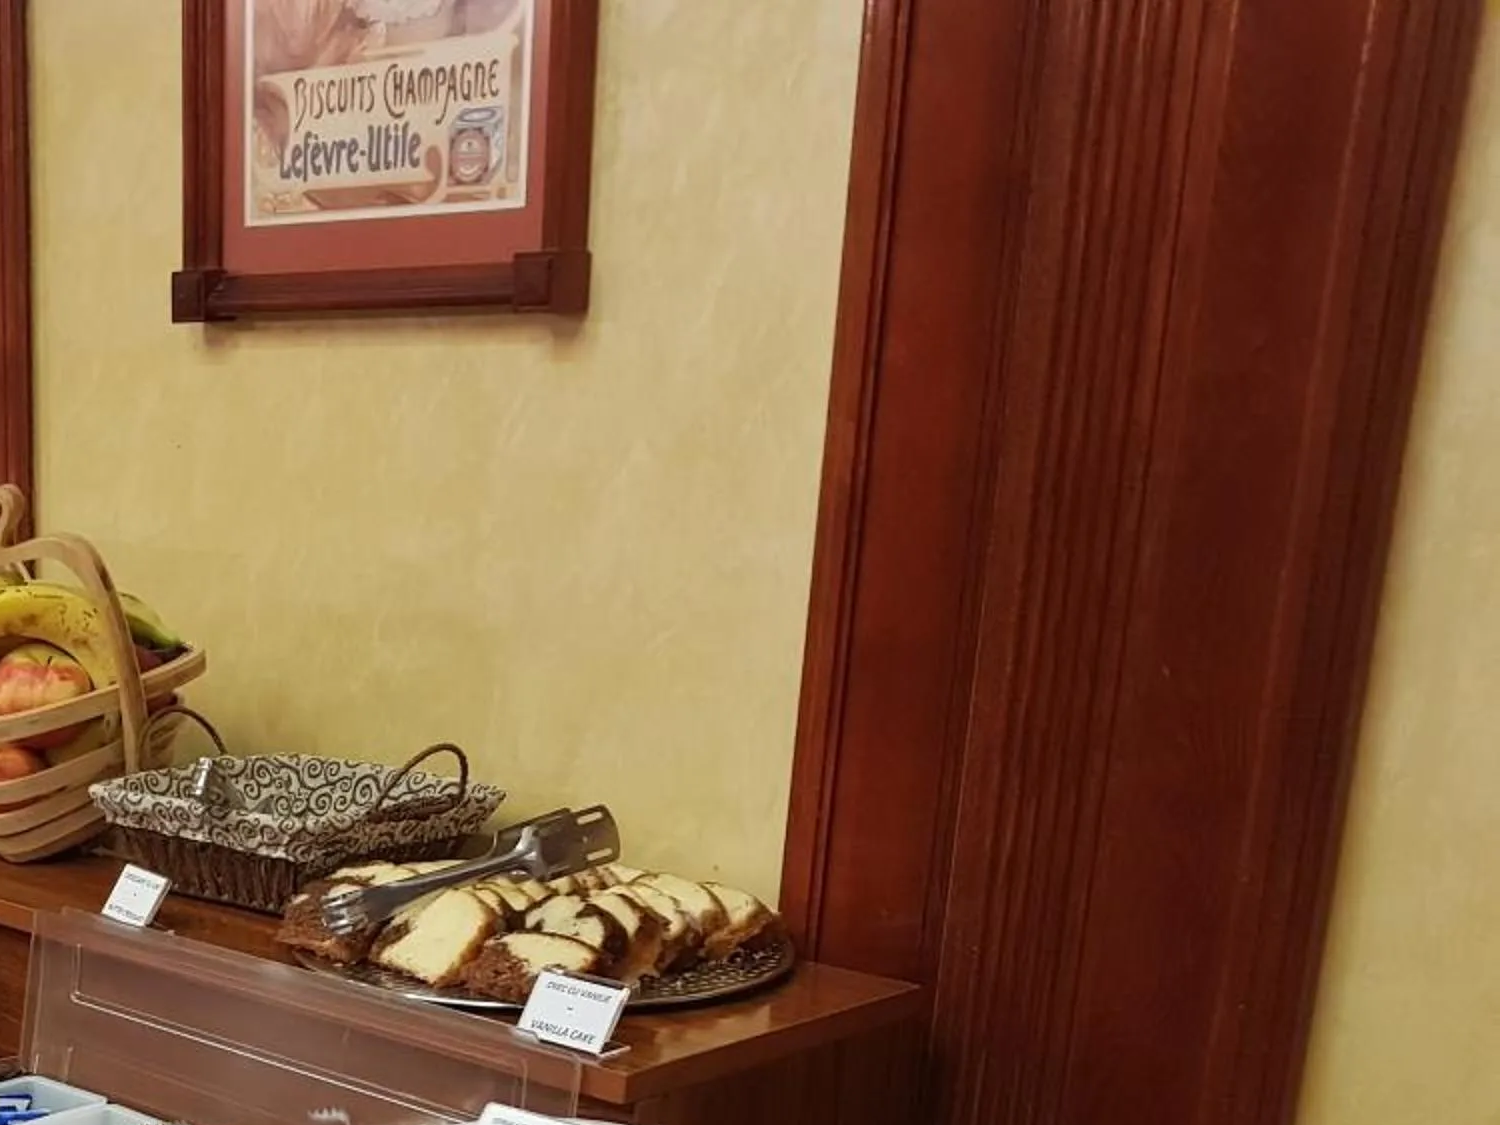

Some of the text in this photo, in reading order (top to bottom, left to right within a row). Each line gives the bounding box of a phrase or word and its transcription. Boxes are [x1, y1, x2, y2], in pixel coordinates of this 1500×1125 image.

[293, 59, 500, 130] BISCUITS CHAMPAGNE
[280, 121, 421, 182] Lefèvre-Utile
[530, 1018, 569, 1038] VANILLA
